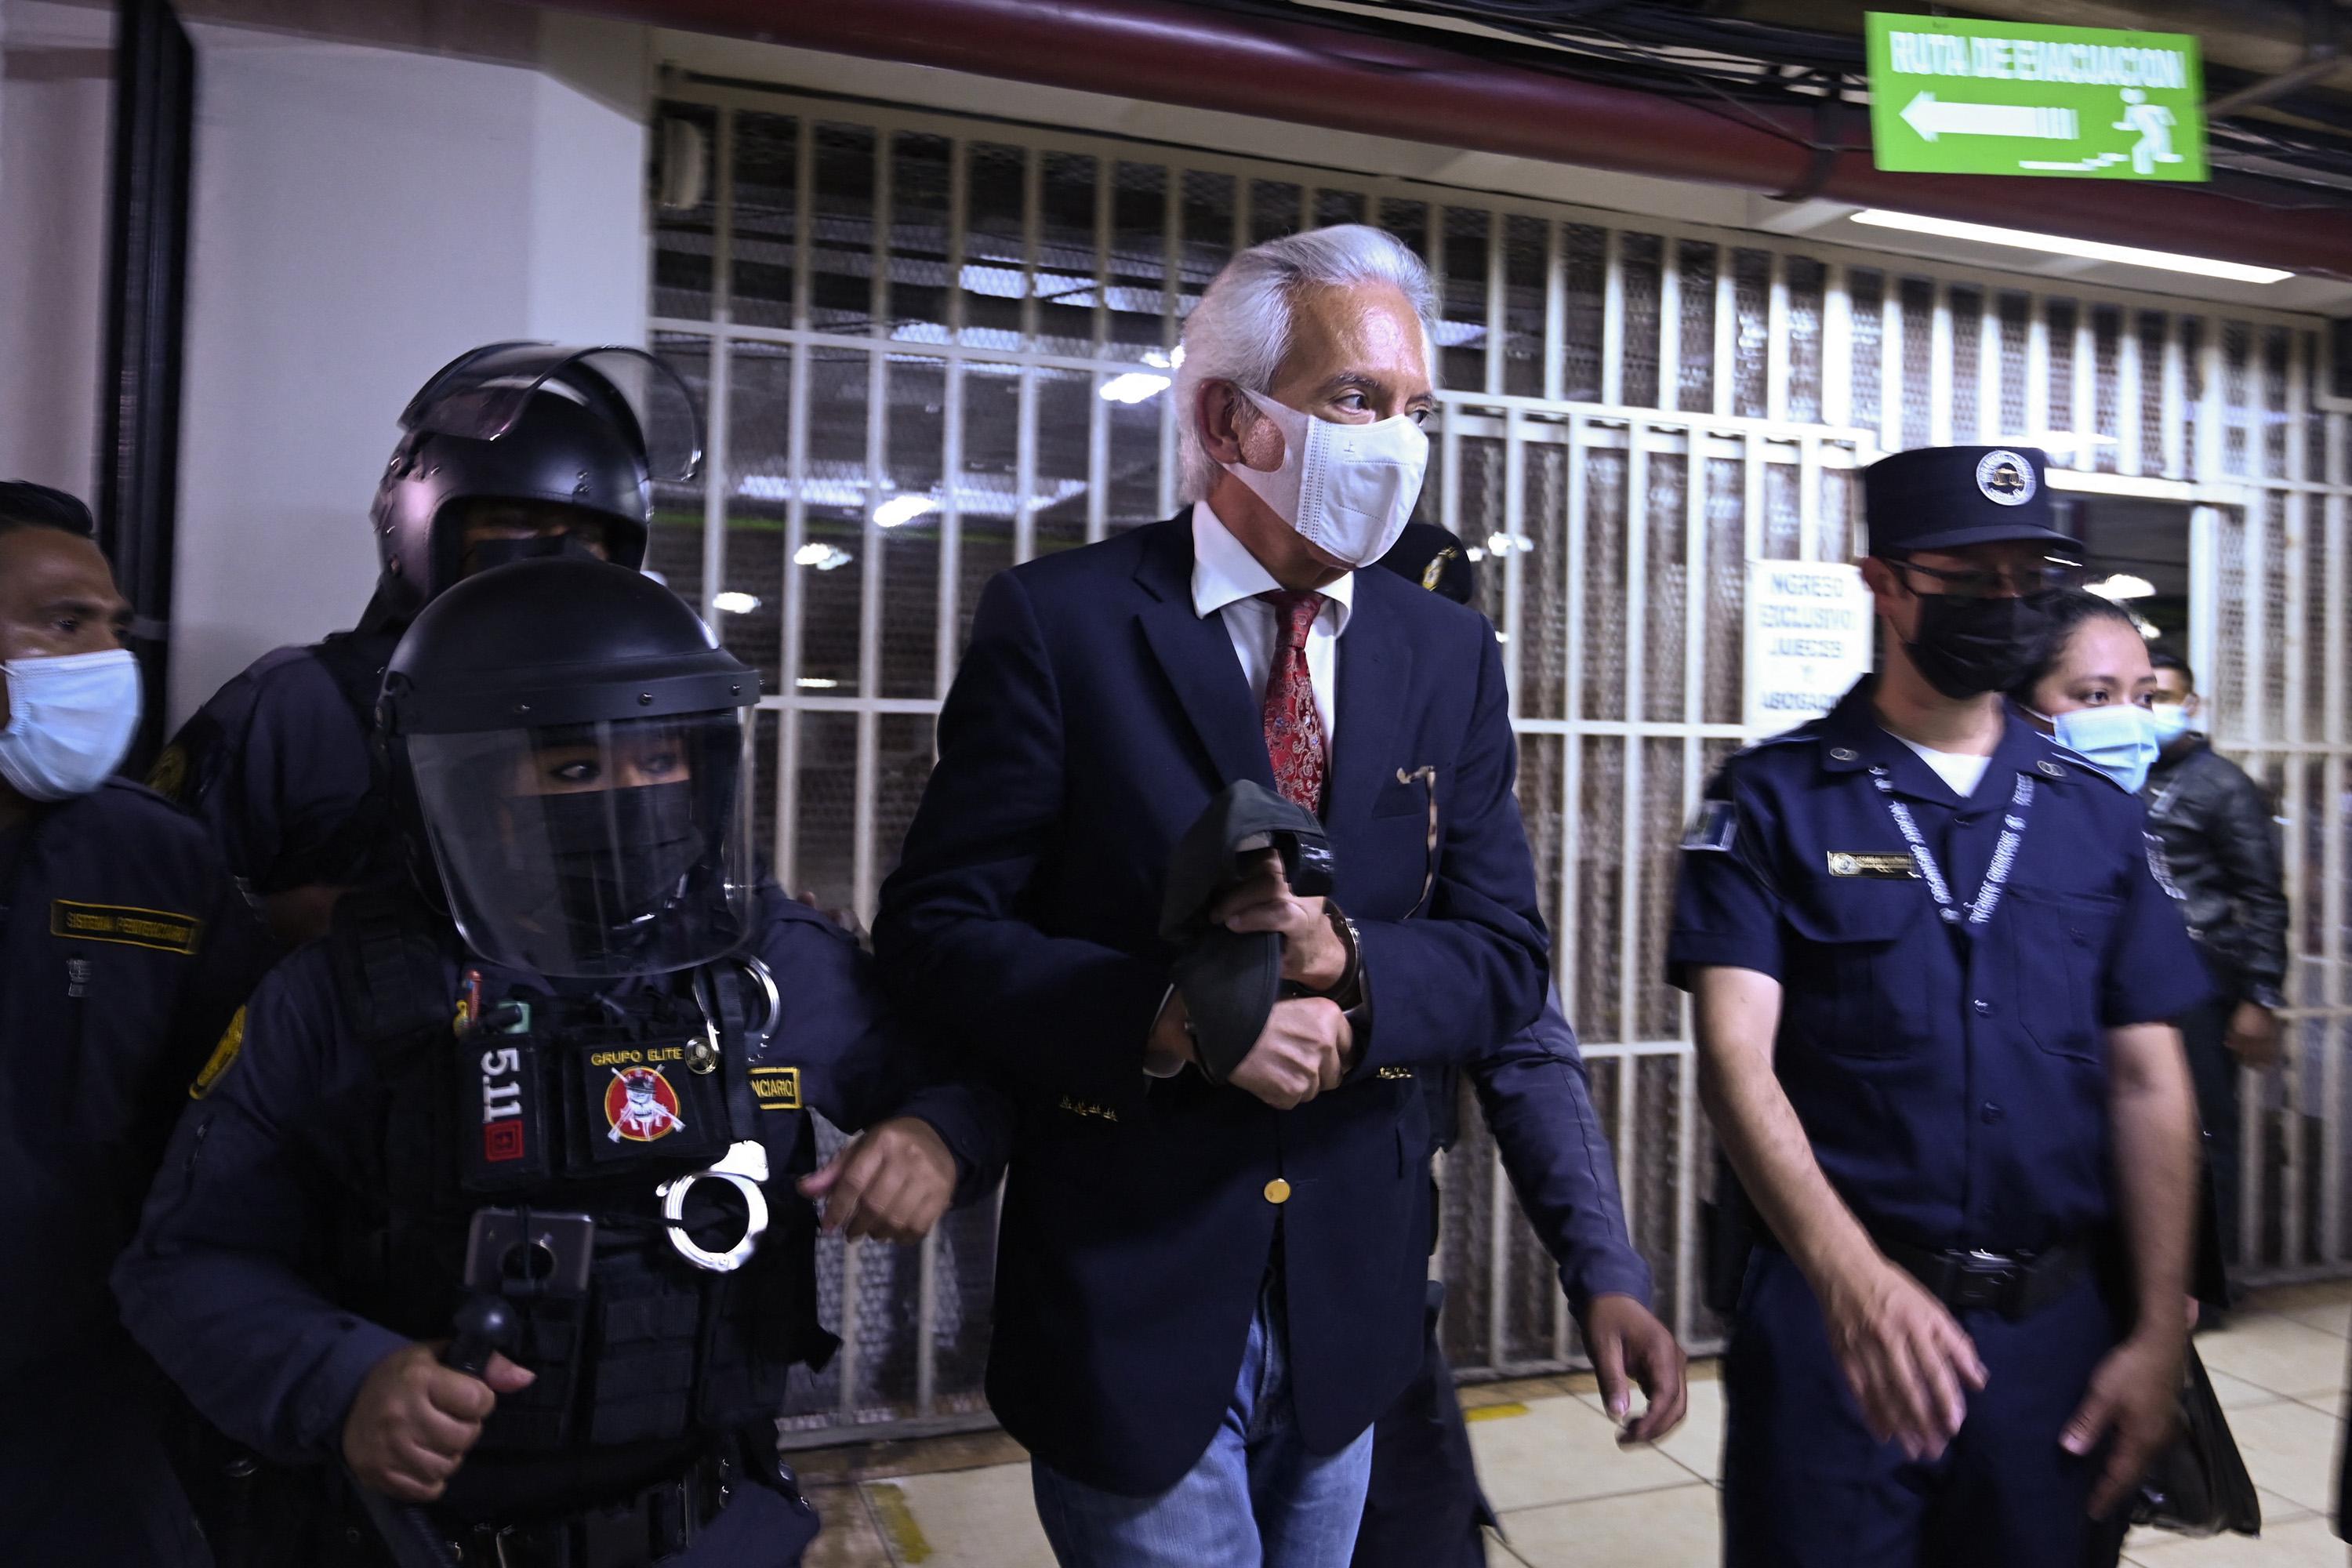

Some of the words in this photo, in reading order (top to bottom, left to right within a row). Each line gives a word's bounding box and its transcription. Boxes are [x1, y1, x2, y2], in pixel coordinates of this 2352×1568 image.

[1889, 31, 1969, 76] RUTA
[1970, 37, 2013, 78] DE
[591, 1049, 643, 1066] GRUPO
[648, 1046, 684, 1062] ELITE
[750, 1079, 796, 1098] NCIARIO
